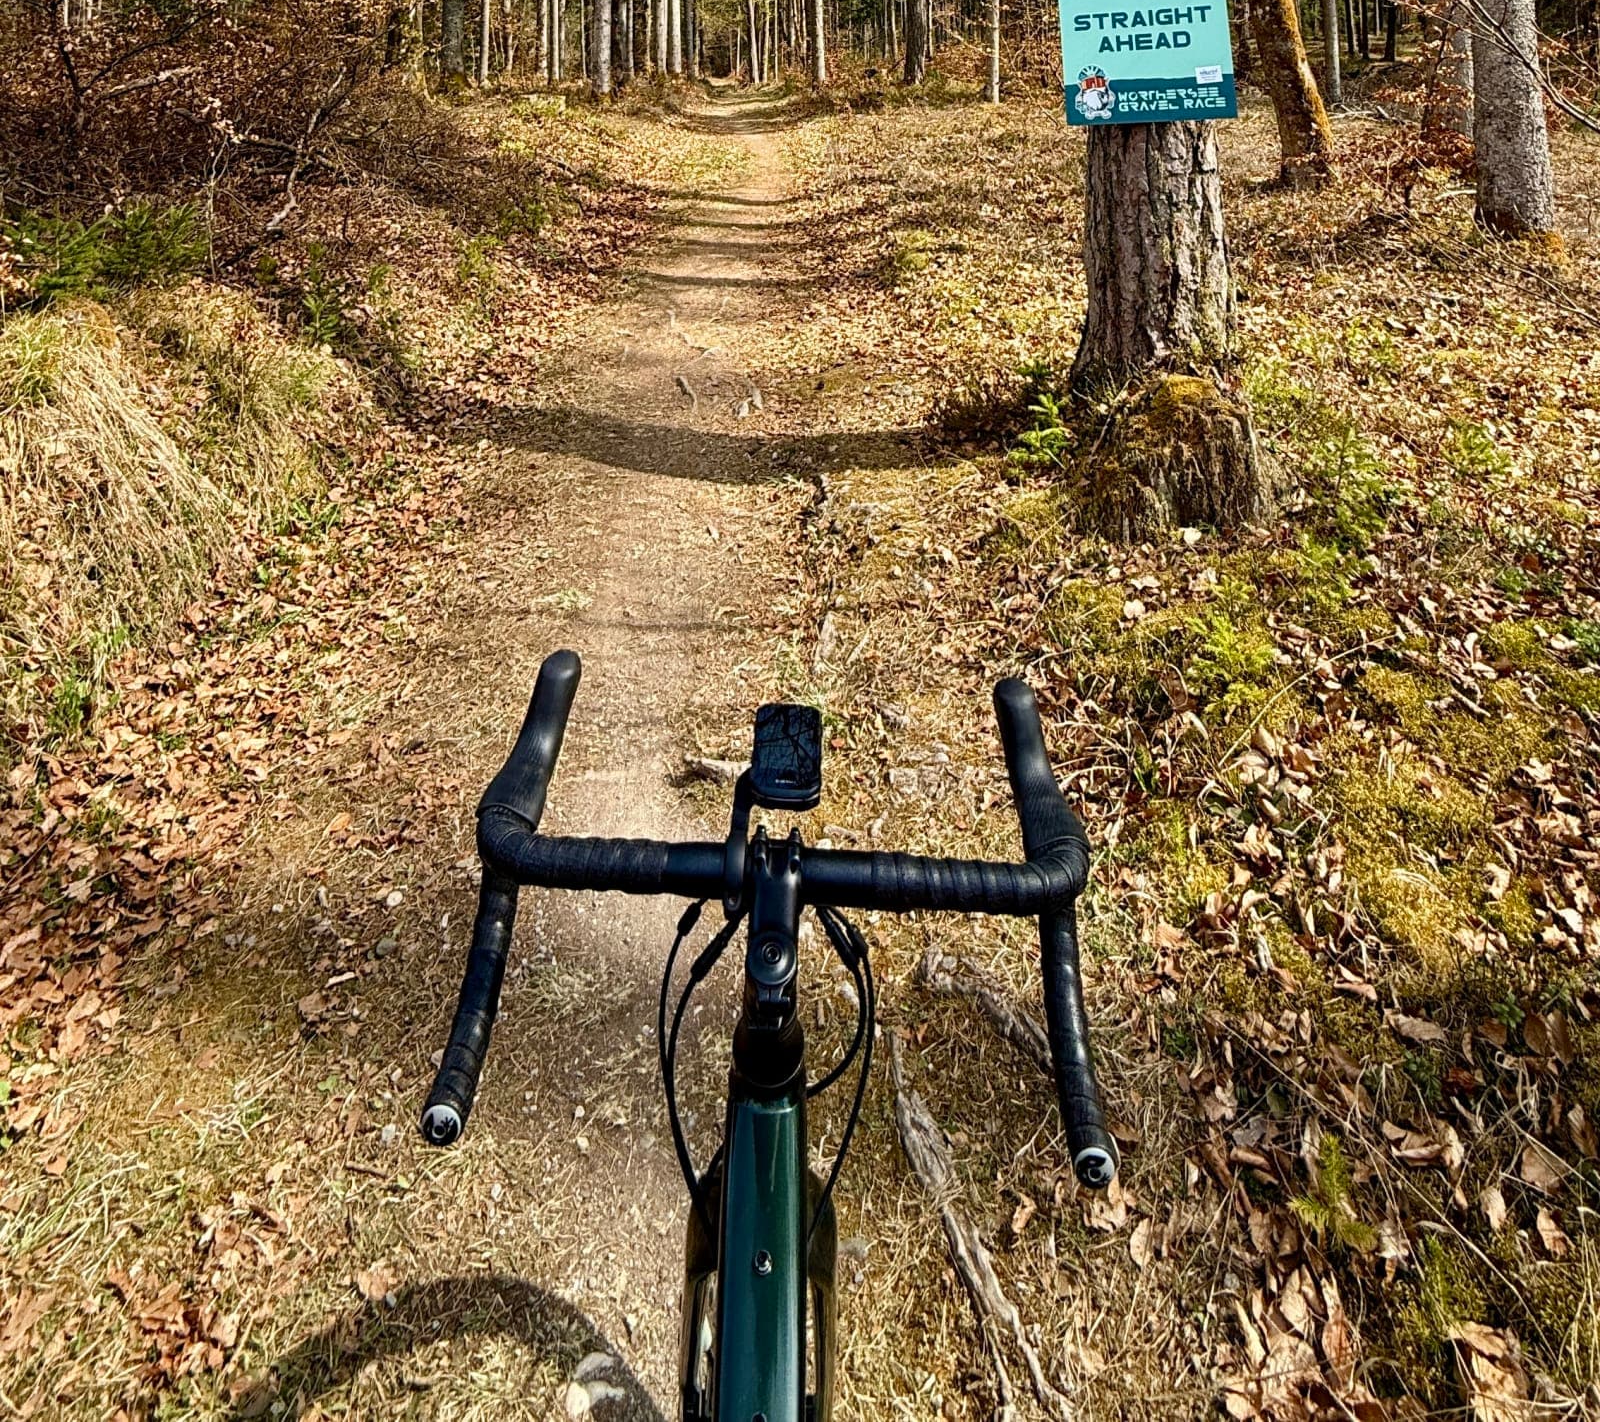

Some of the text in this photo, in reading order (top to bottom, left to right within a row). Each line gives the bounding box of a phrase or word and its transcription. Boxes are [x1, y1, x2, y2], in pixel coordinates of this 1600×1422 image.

[1073, 5, 1212, 32] STRAIGHT
[1098, 30, 1191, 53] AHEAD
[1118, 96, 1227, 112] GRAVEL RACE
